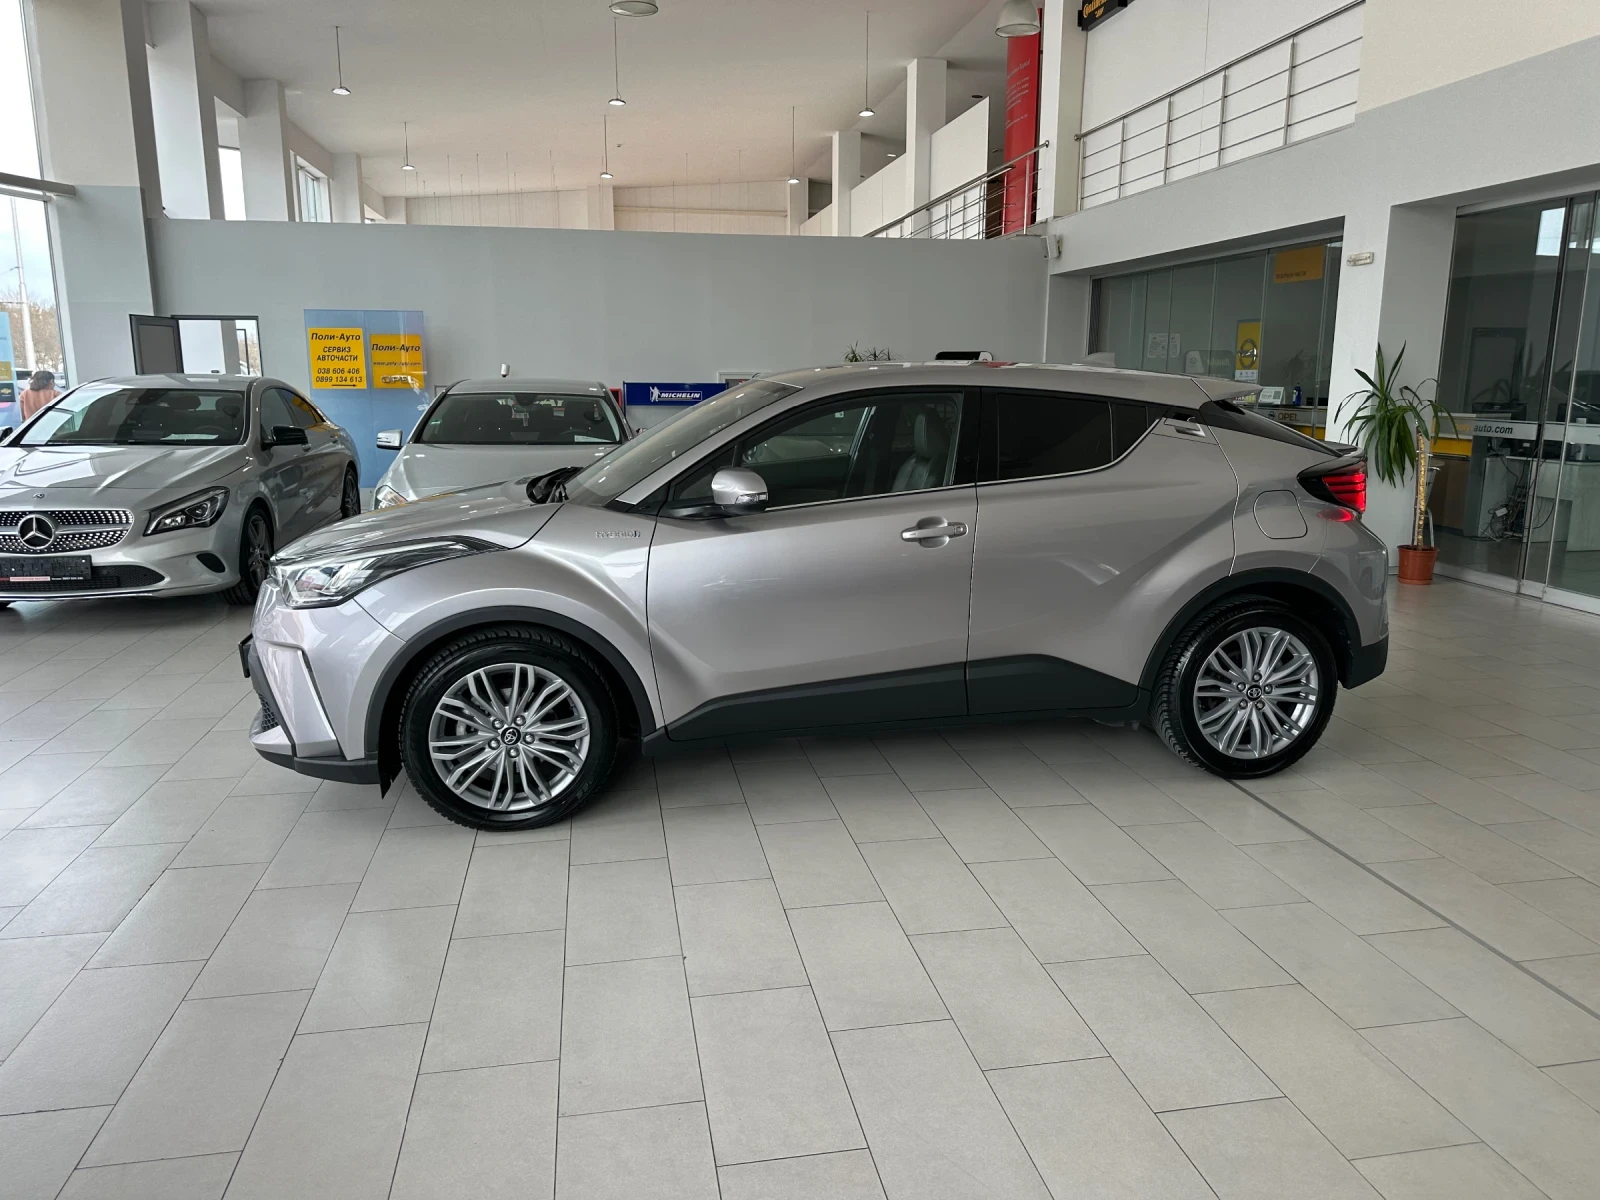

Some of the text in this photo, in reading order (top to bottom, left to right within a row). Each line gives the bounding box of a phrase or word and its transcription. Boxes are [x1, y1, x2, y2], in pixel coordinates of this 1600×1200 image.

[311, 332, 361, 342] Поли-Ауто
[371, 343, 421, 353] Поли-Ауто
[316, 354, 358, 362] АВТОЧАСТИ
[317, 367, 360, 375] 038 606 406
